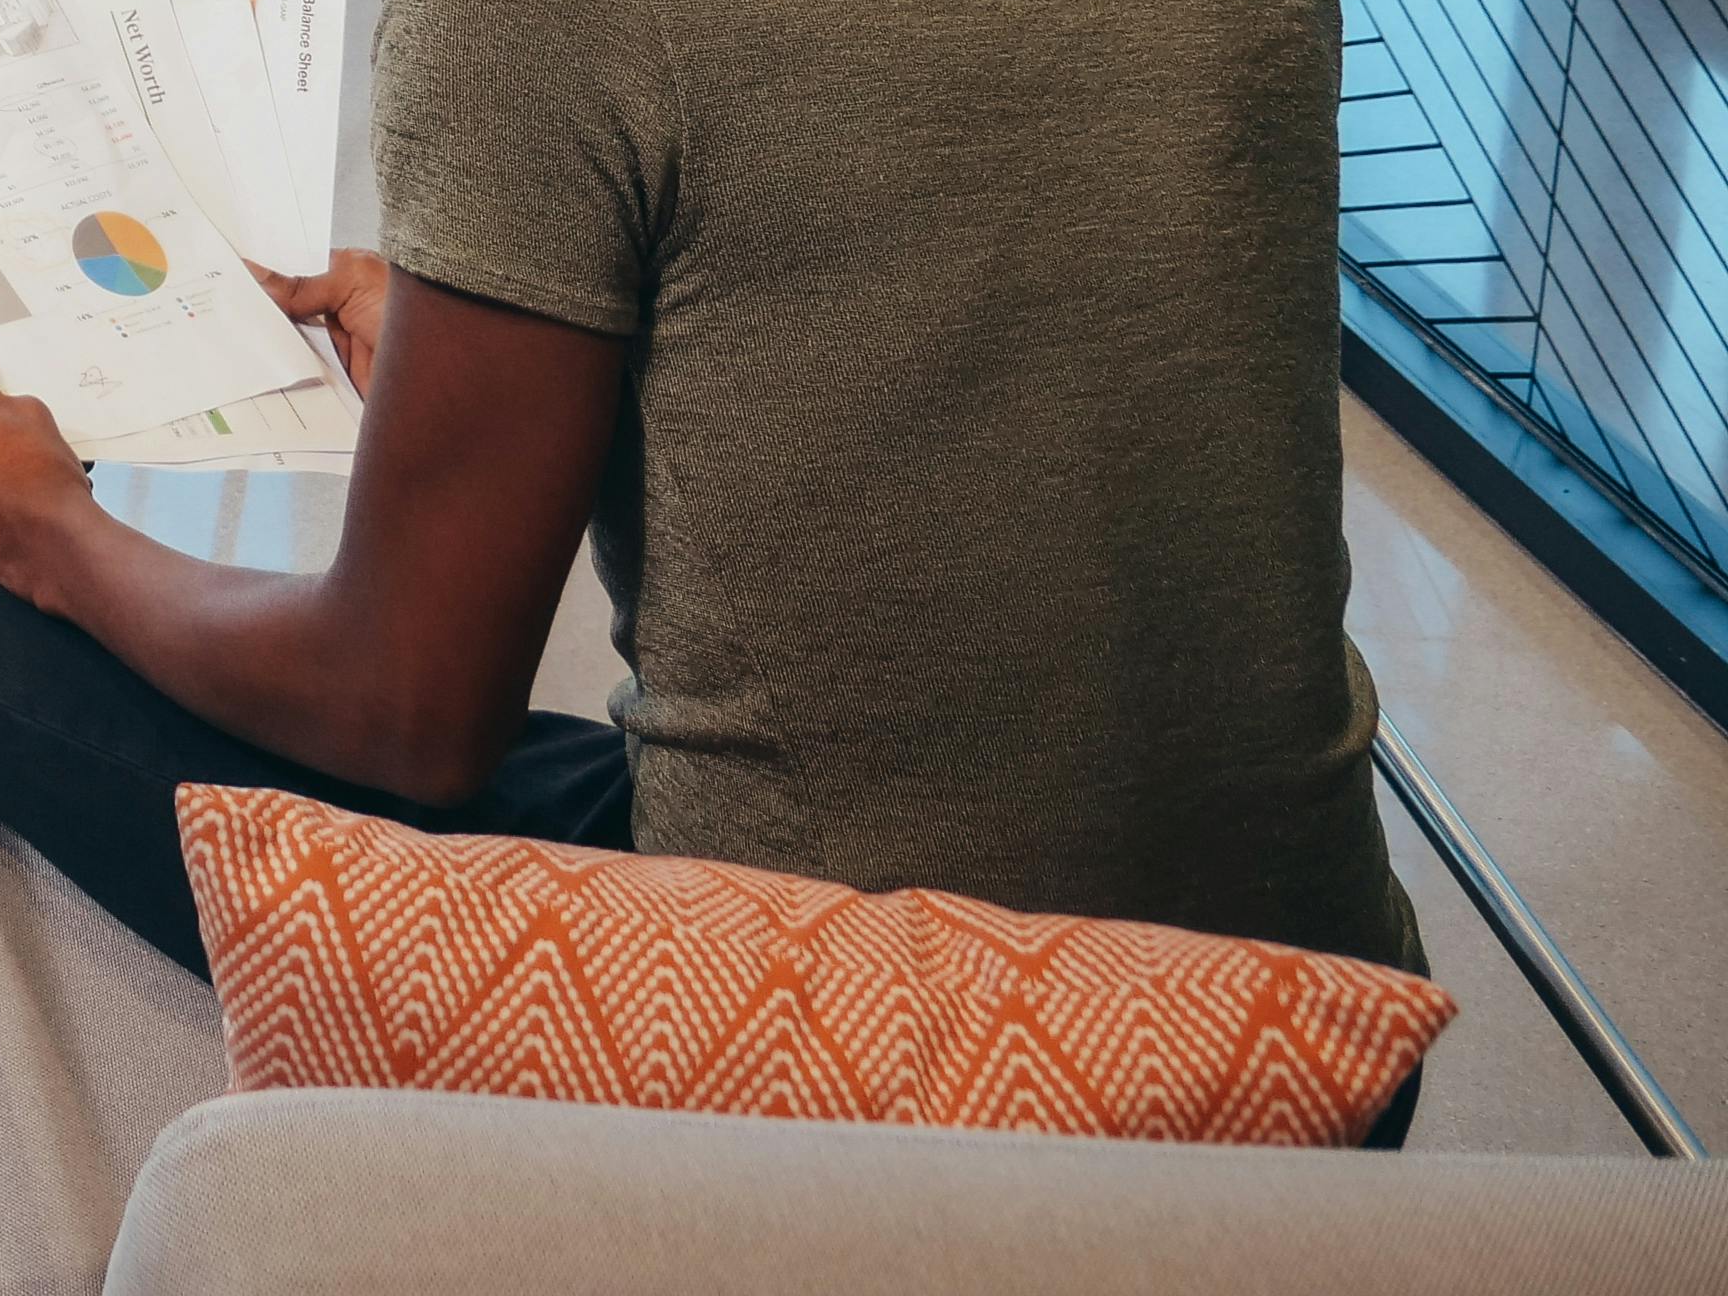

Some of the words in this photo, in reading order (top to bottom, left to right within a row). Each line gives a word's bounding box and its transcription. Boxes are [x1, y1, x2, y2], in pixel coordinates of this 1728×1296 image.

[121, 8, 144, 41] Net
[135, 44, 166, 105] Worth
[296, 52, 312, 93] Sheet
